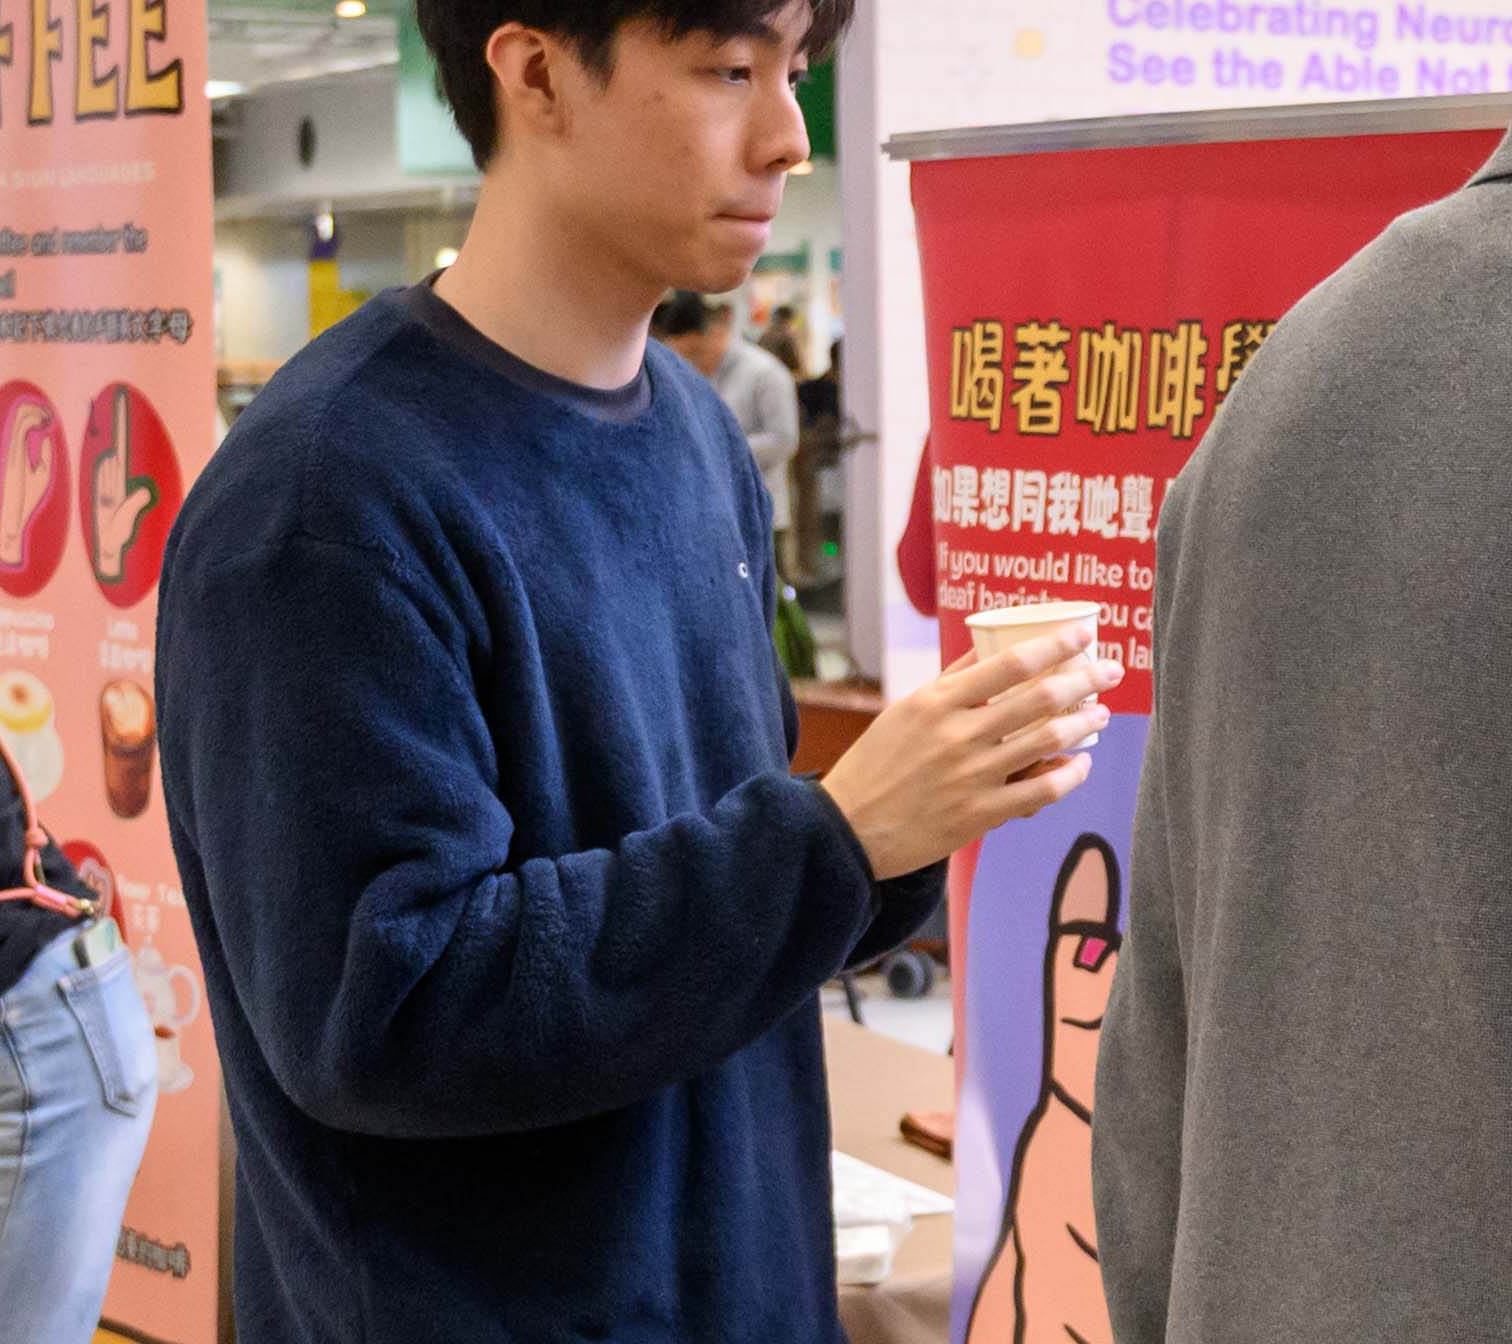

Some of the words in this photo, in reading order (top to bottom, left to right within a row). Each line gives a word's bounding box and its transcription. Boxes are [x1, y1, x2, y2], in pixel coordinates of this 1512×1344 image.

[1107, 43, 1195, 87] See
[1212, 48, 1284, 89] the
[1301, 52, 1400, 94] Able
[950, 550, 989, 581] you
[994, 552, 1071, 585] would
[1074, 553, 1124, 589] like
[1128, 559, 1155, 592] to
[938, 578, 975, 610] deaf
